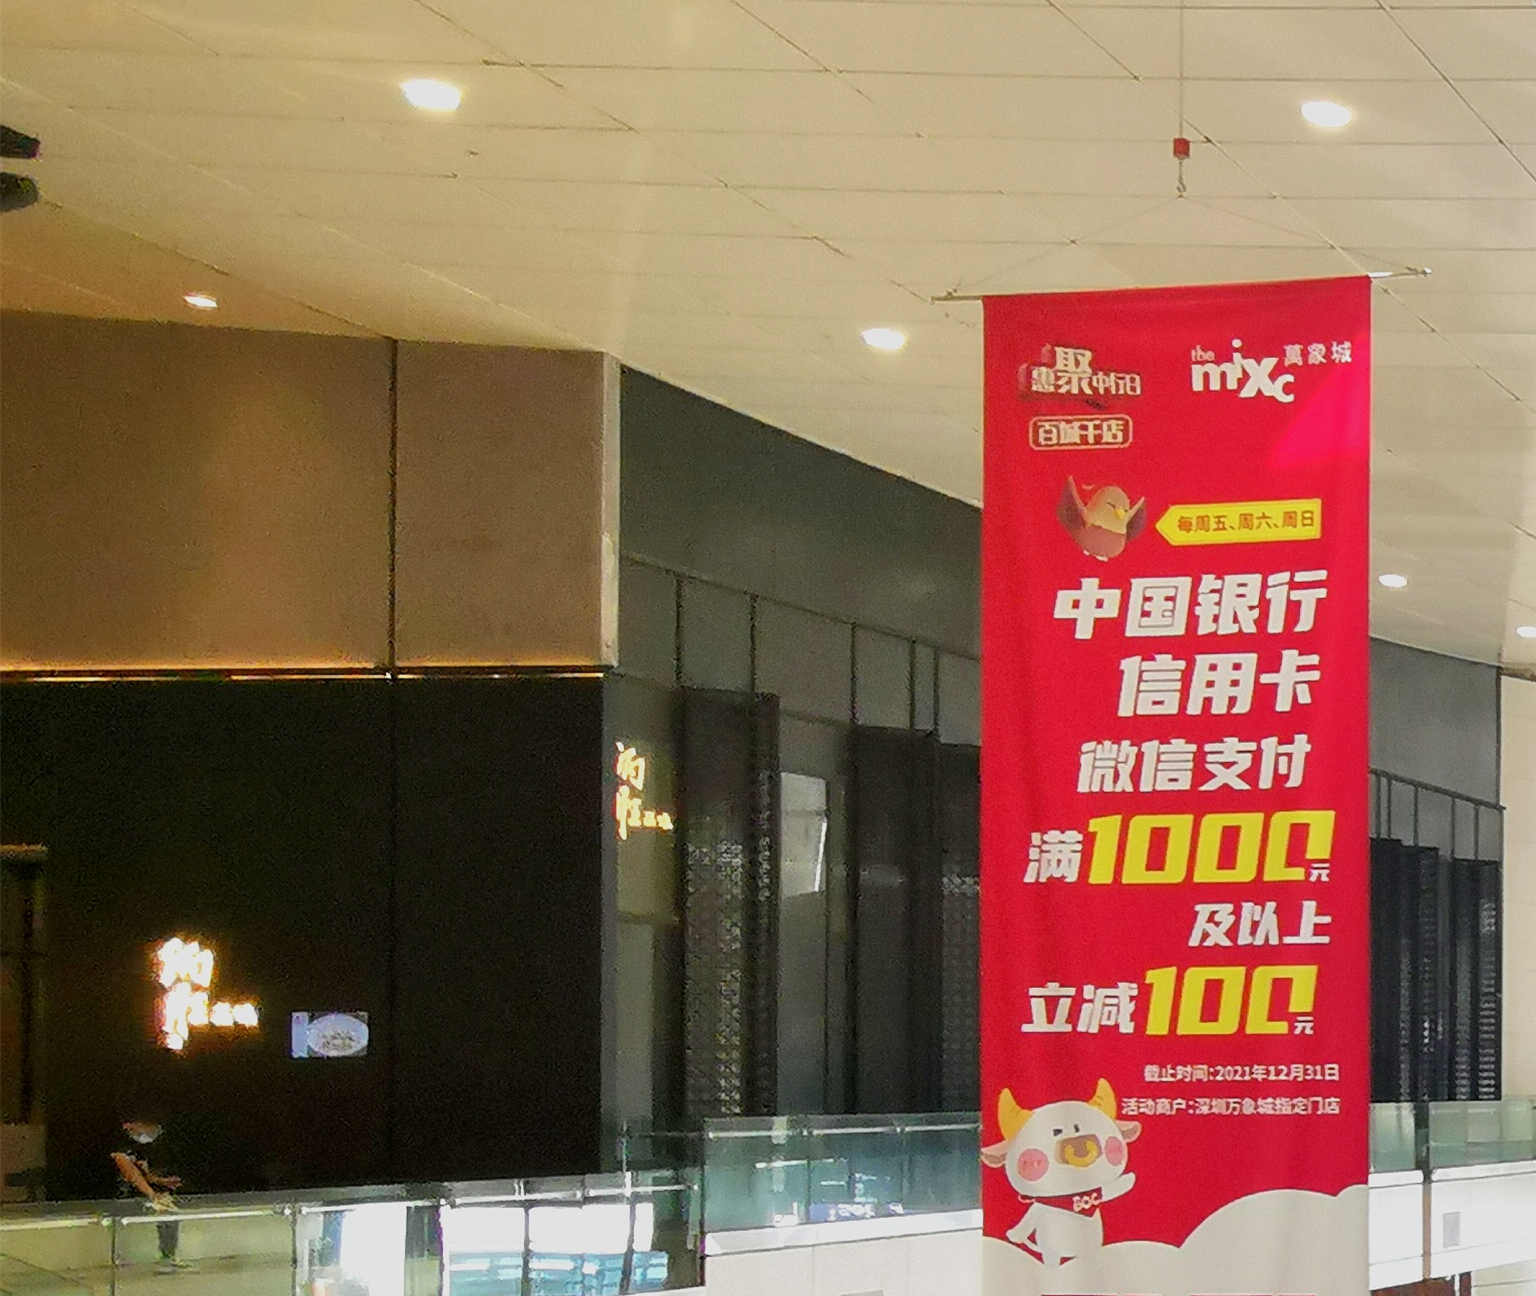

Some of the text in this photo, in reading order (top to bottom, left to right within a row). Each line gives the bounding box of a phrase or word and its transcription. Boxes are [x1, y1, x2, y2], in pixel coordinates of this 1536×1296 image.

[1191, 345, 1215, 361] the
[1283, 341, 1353, 366] 萬象城
[1037, 420, 1124, 445] 百城千店
[1177, 510, 1315, 534] 每周五、周六、周日
[1052, 570, 1328, 640] 中国银行
[1117, 649, 1322, 717] 信用卡
[1076, 733, 1312, 795] 微信支付
[1188, 903, 1331, 947] 及以上
[1072, 1191, 1102, 1213] BOC
